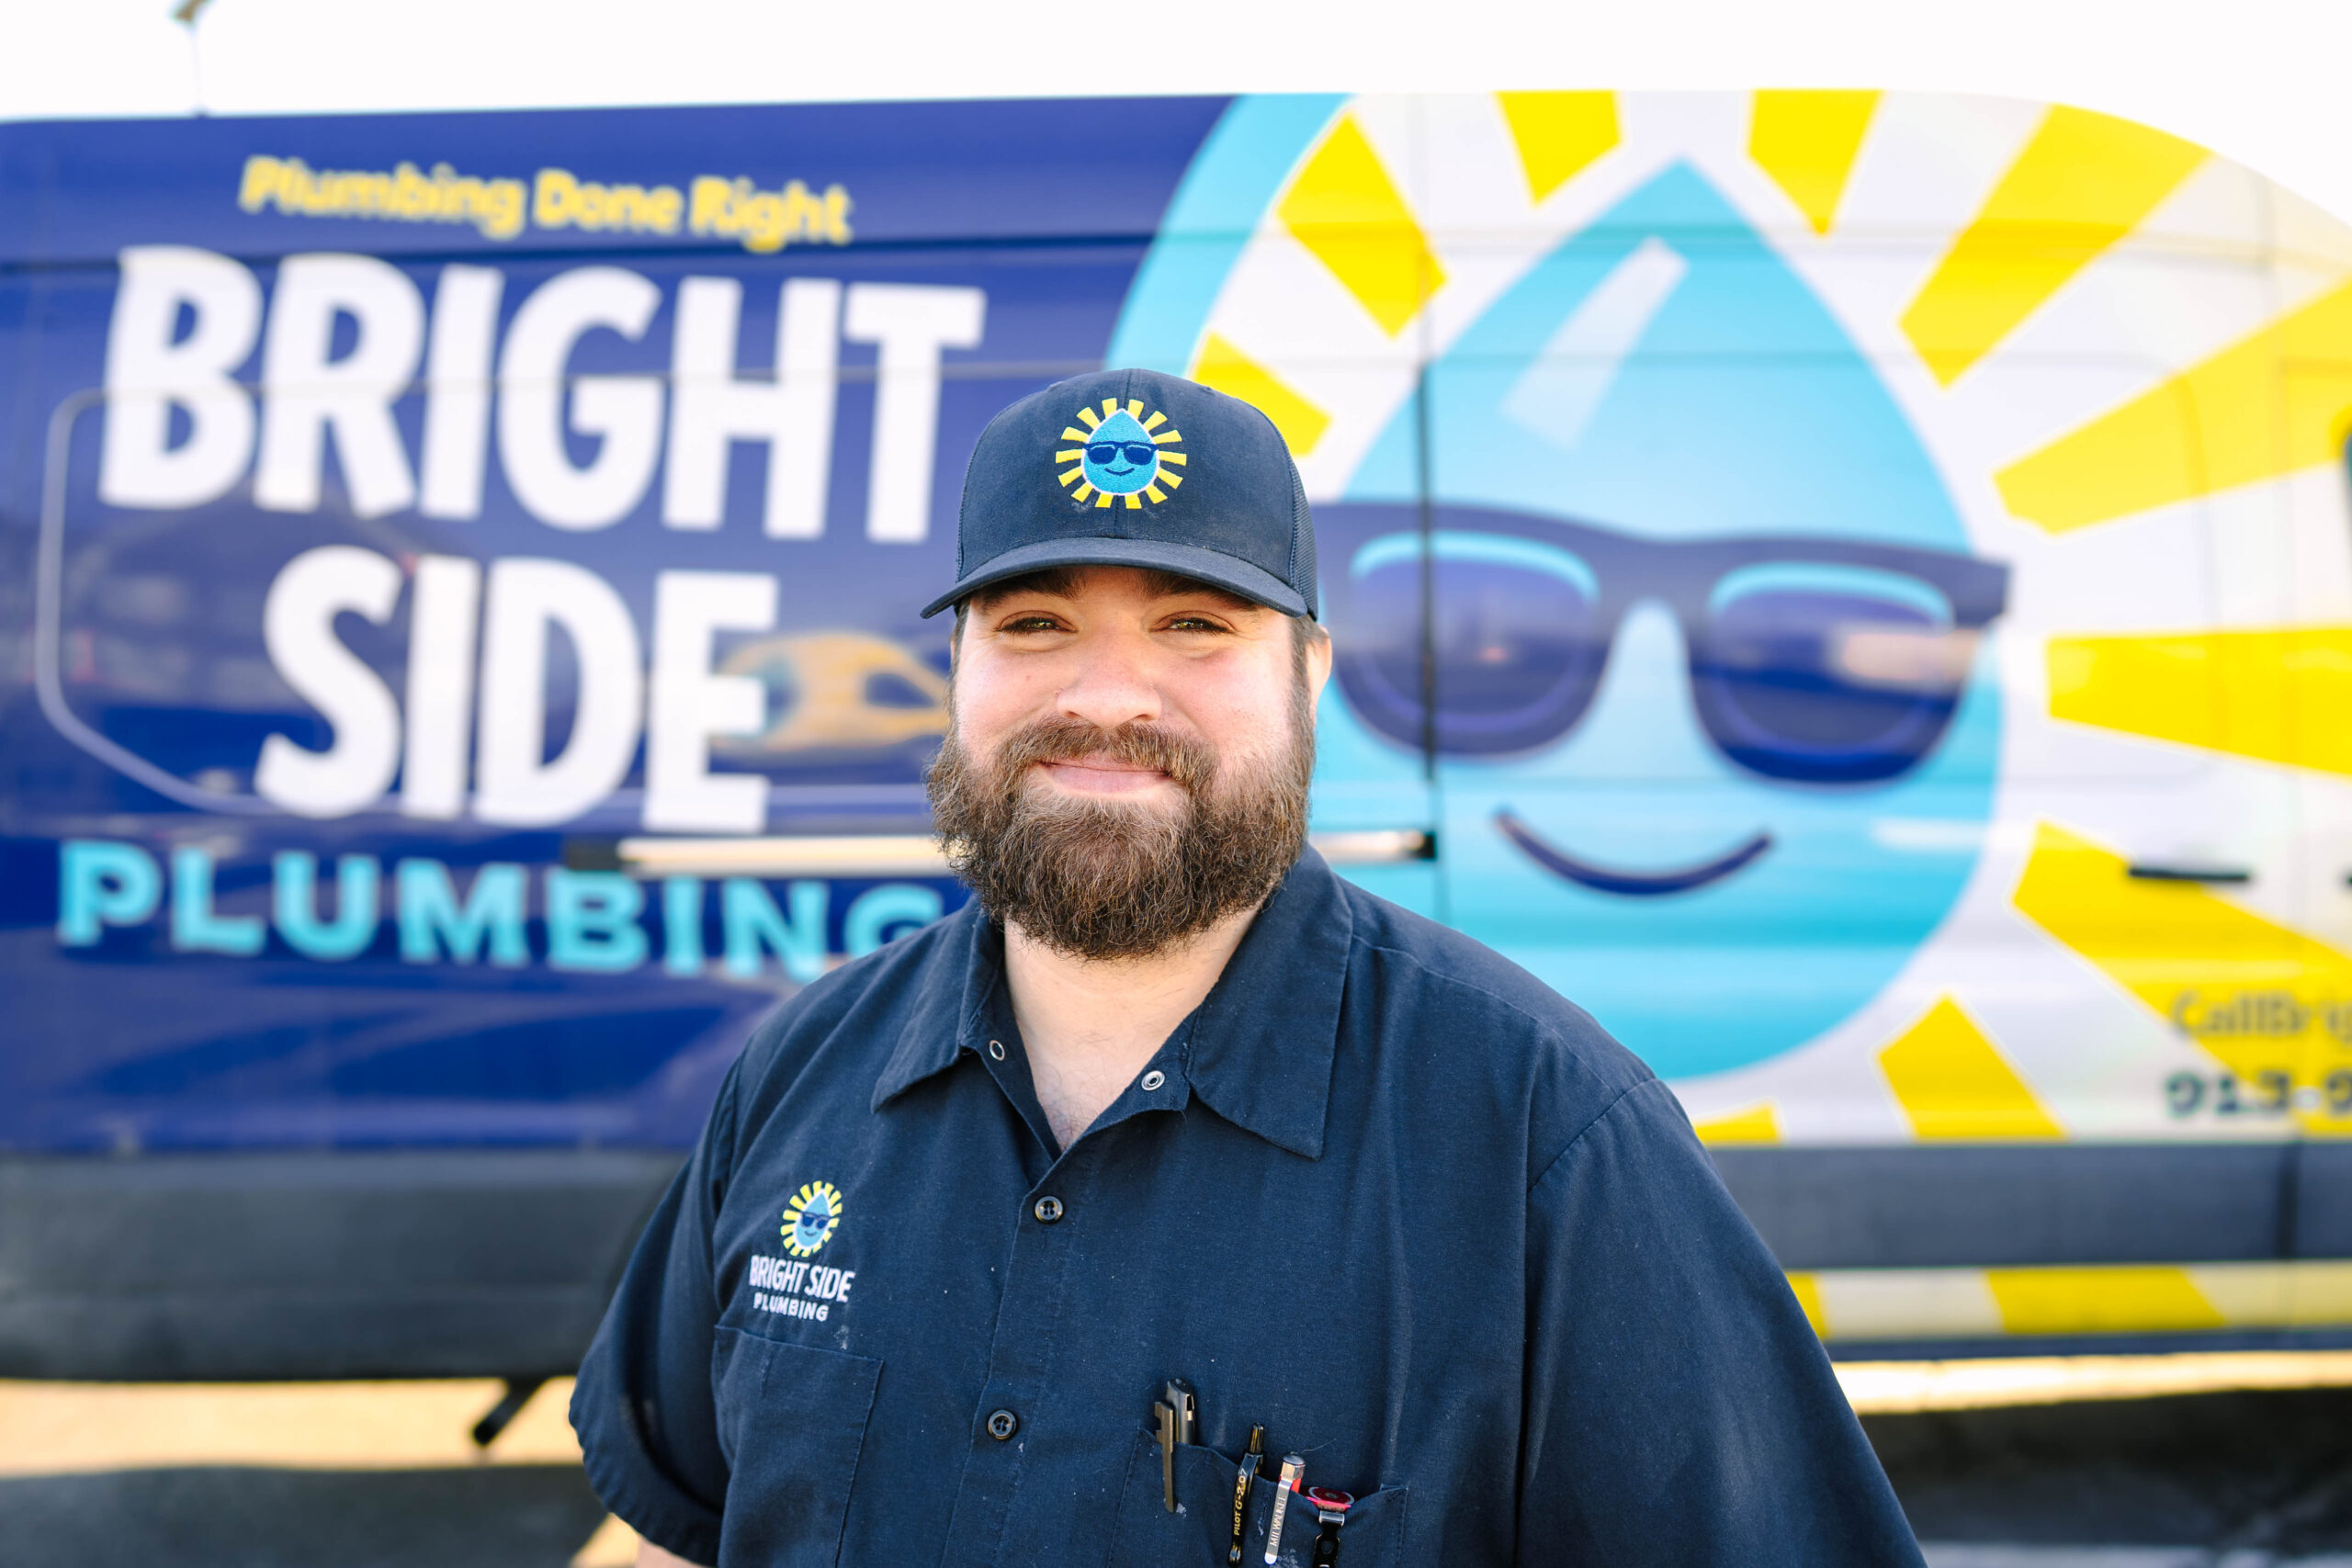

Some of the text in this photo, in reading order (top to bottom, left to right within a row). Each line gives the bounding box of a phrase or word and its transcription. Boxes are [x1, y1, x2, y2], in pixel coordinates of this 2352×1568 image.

[241, 155, 854, 254] Plumbing Done Right
[98, 244, 987, 544] BRIGHT
[254, 545, 778, 833] SIDE
[58, 840, 944, 978] PLUMBING
[749, 1255, 855, 1303] BRIGHT SIDE
[752, 1292, 829, 1323] PLUMBING
[1233, 1511, 1241, 1536] PILOT
